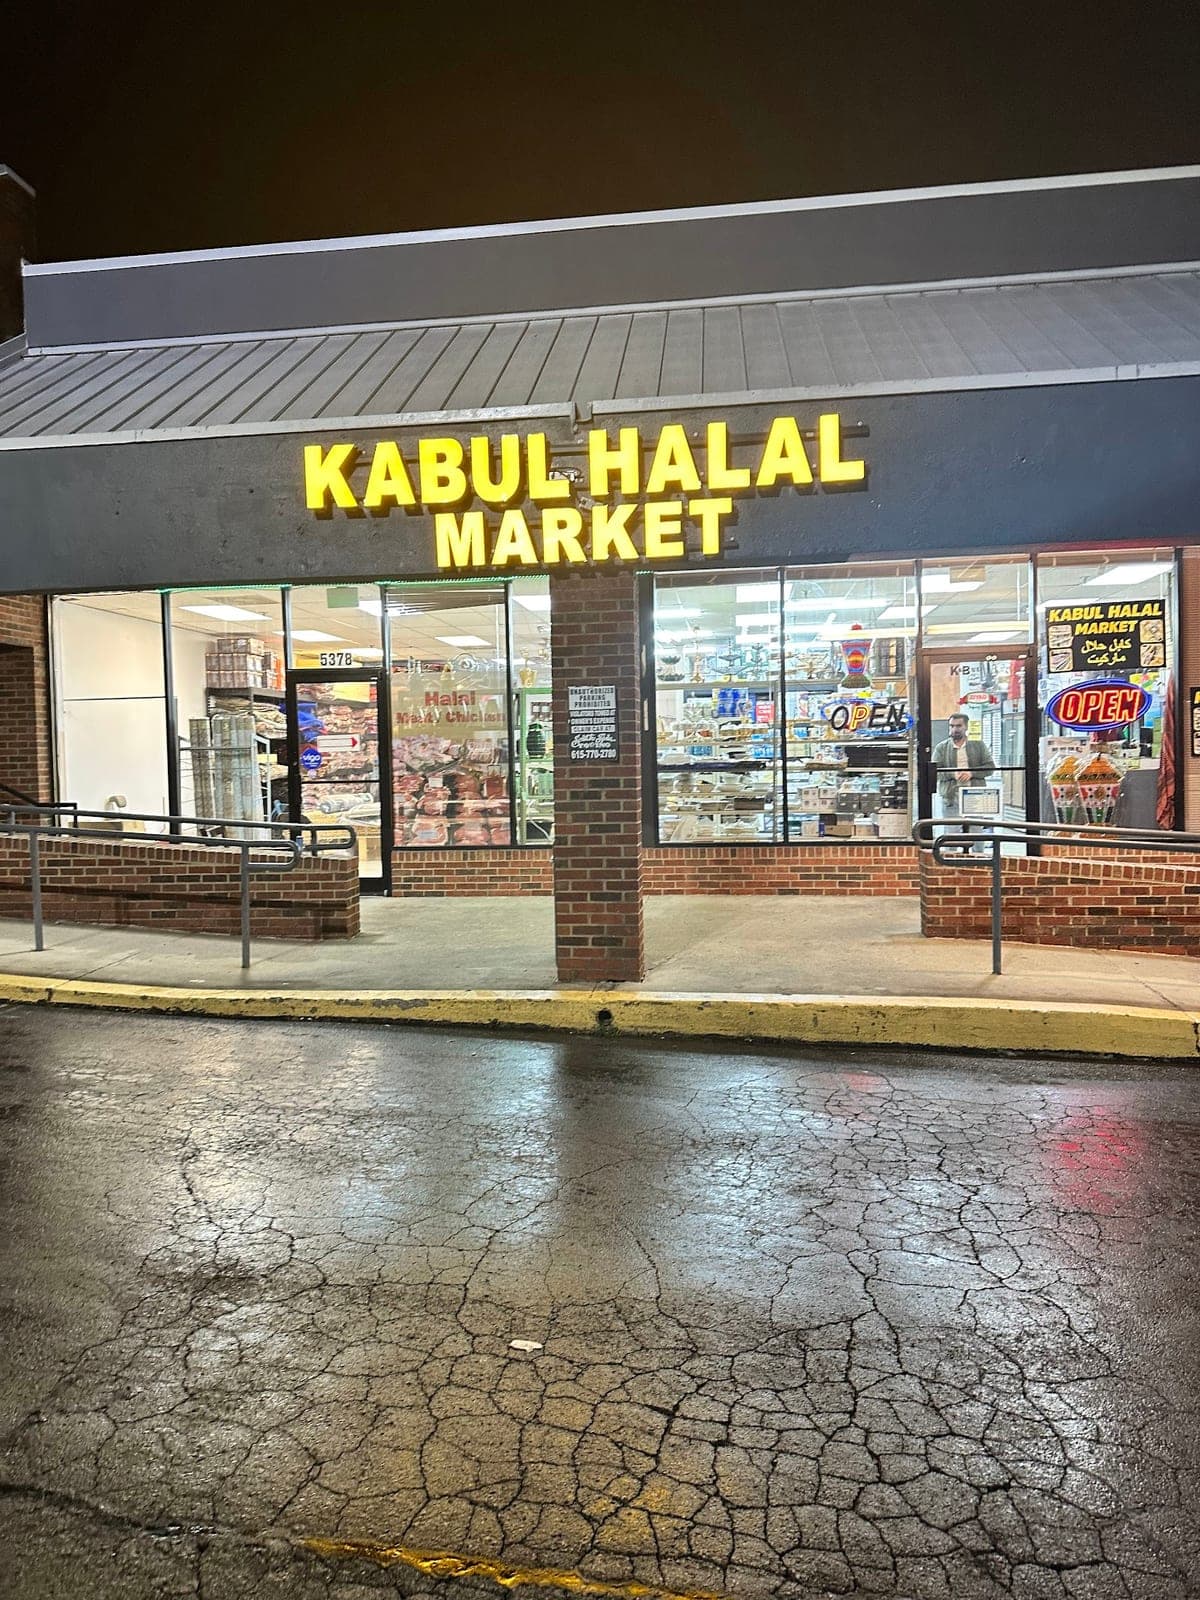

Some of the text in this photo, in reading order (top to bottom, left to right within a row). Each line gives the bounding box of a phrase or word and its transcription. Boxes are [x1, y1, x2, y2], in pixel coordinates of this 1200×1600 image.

[304, 413, 866, 510] KABUL HALAL
[434, 496, 734, 569] MARKET
[1048, 603, 1162, 622] KABUL HALAL
[1074, 620, 1138, 635] MARKET
[320, 653, 352, 666] 5378
[425, 690, 476, 706] Halal
[1060, 689, 1141, 723] OPEN
[832, 704, 905, 730] OPEN
